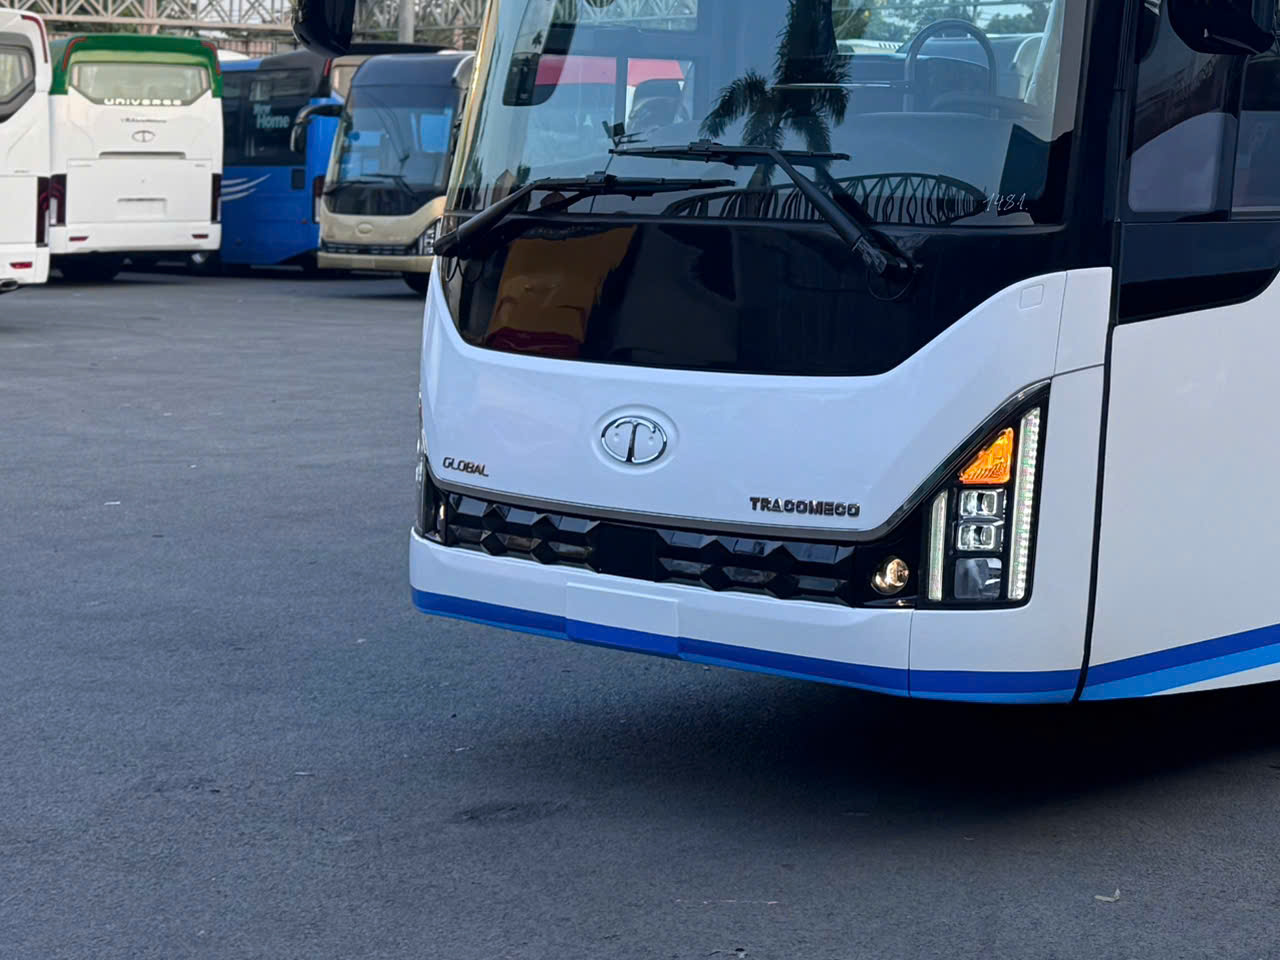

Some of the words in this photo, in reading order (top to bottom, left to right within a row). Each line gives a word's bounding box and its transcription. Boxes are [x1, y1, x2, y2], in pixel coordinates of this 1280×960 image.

[256, 111, 290, 129] Home
[442, 456, 489, 478] GLOBAL
[749, 496, 861, 518] TRACOMECO
